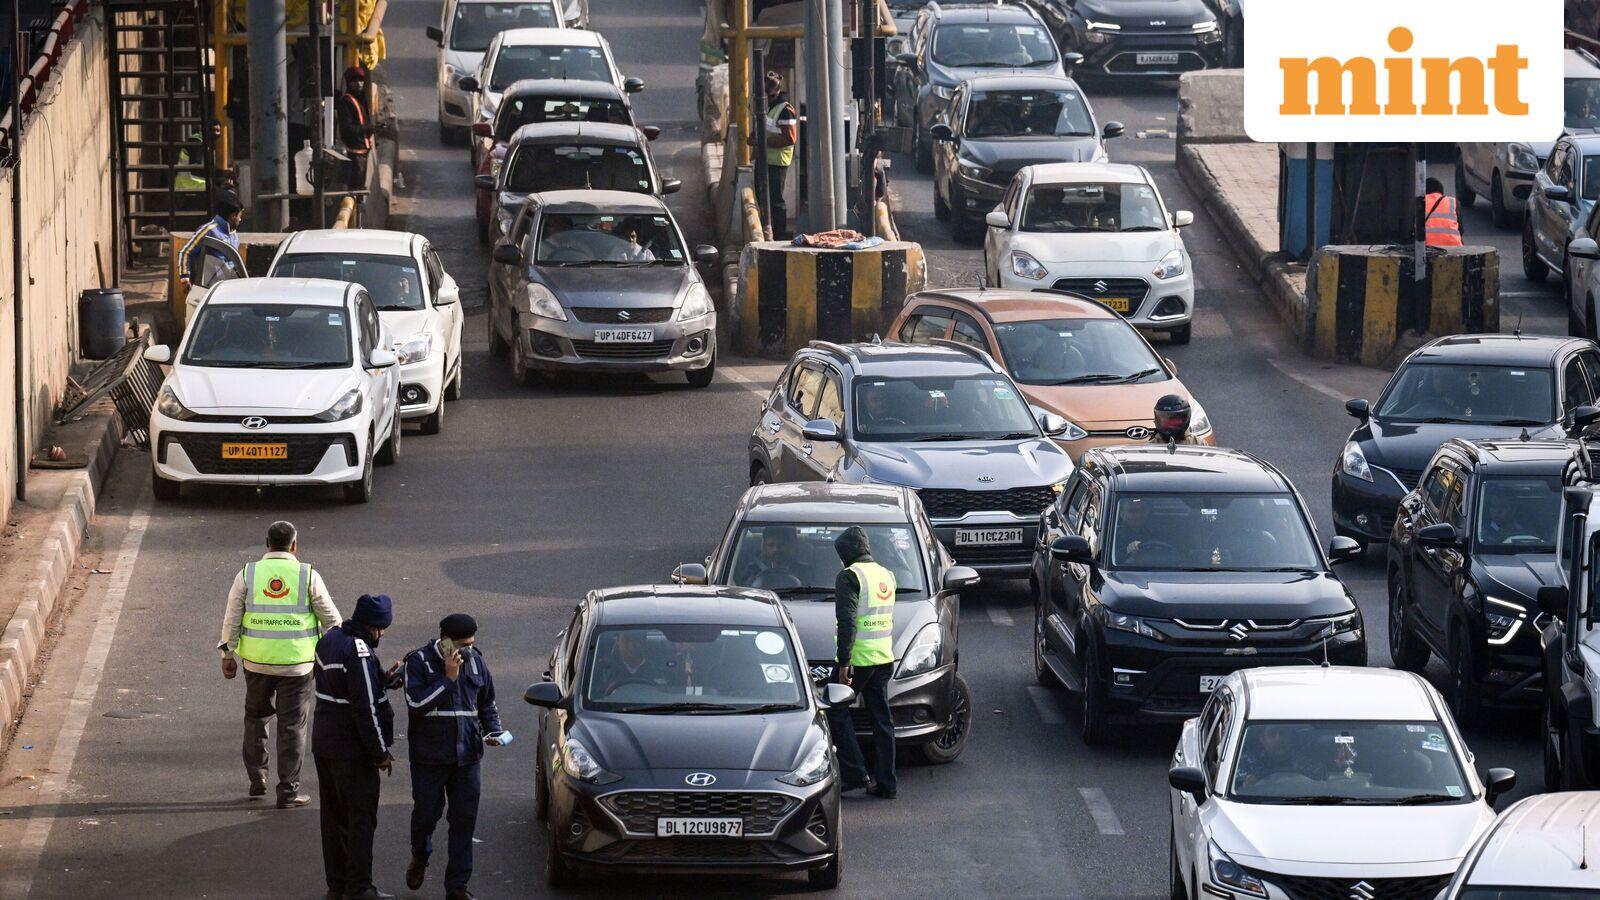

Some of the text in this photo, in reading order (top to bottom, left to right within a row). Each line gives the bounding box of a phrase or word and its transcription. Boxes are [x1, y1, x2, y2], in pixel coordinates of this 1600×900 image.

[600, 331, 652, 341] UP14DF6427
[961, 529, 1022, 543] DL11CC2301
[250, 617, 263, 625] DELHI
[263, 618, 282, 626] TRAFFIC
[665, 821, 742, 834] DL12CU9877
